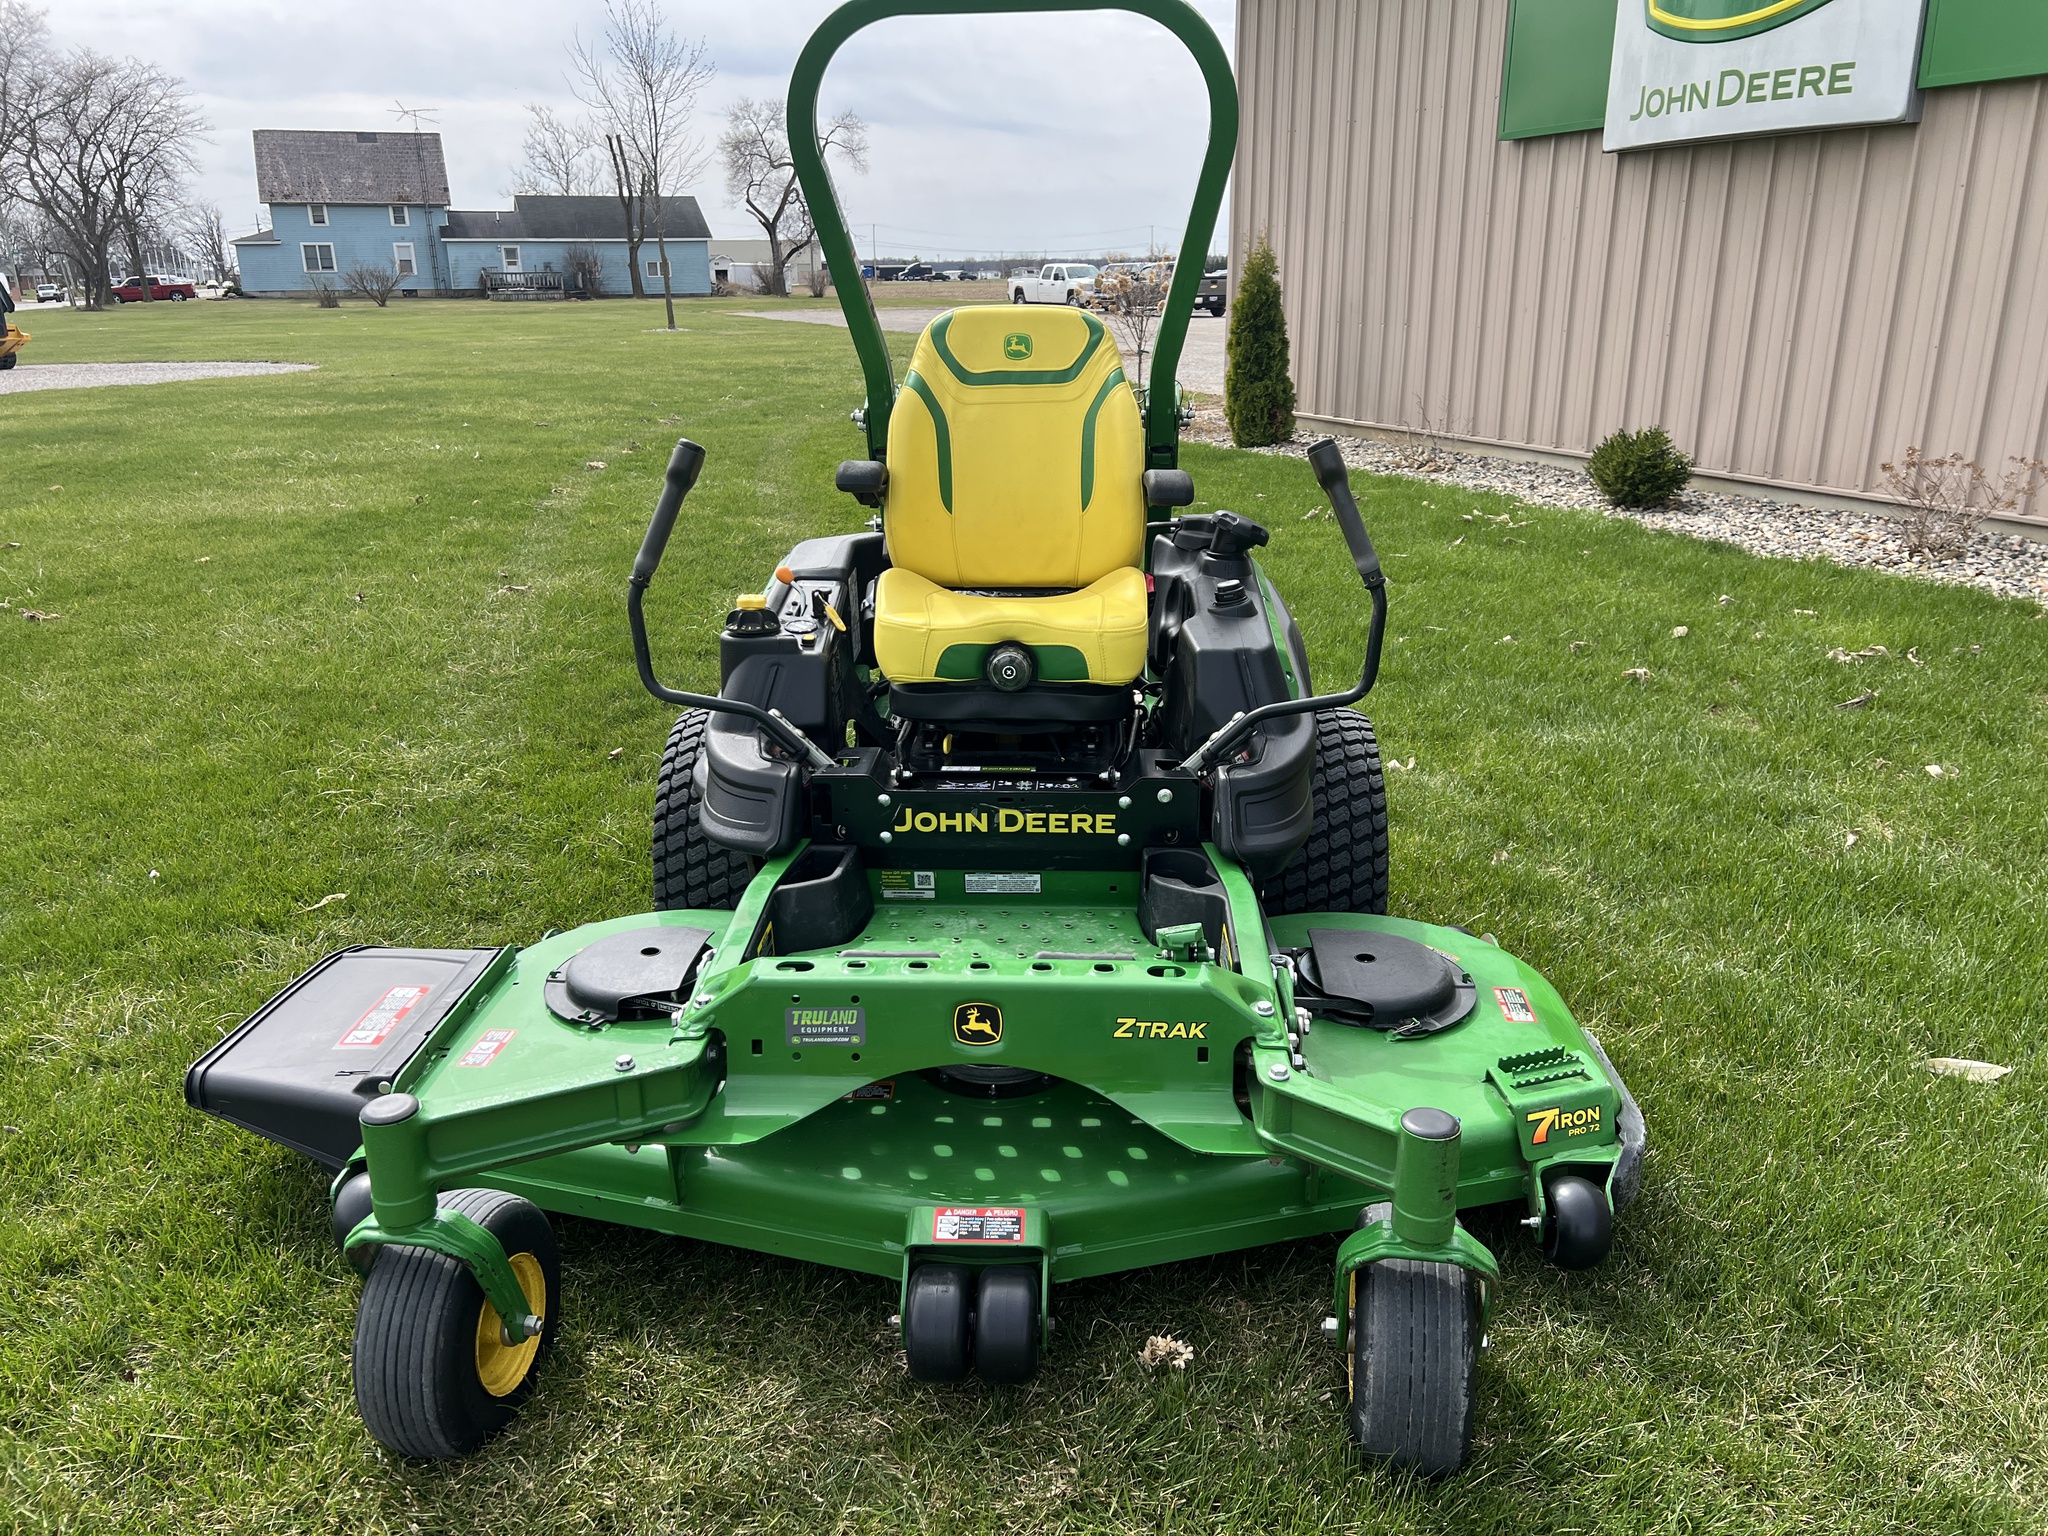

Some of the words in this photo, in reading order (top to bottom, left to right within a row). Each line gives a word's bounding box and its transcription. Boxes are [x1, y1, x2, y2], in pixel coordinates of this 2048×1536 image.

[1629, 80, 1711, 121] JOHN
[1716, 61, 1857, 107] DEERE
[894, 807, 988, 833] JOHN
[999, 808, 1116, 834] DEERE
[792, 1010, 858, 1025] TRULAND
[1113, 1017, 1209, 1039] ZTRAK
[1568, 1126, 1587, 1137] PRO
[1589, 1123, 1600, 1133] 72
